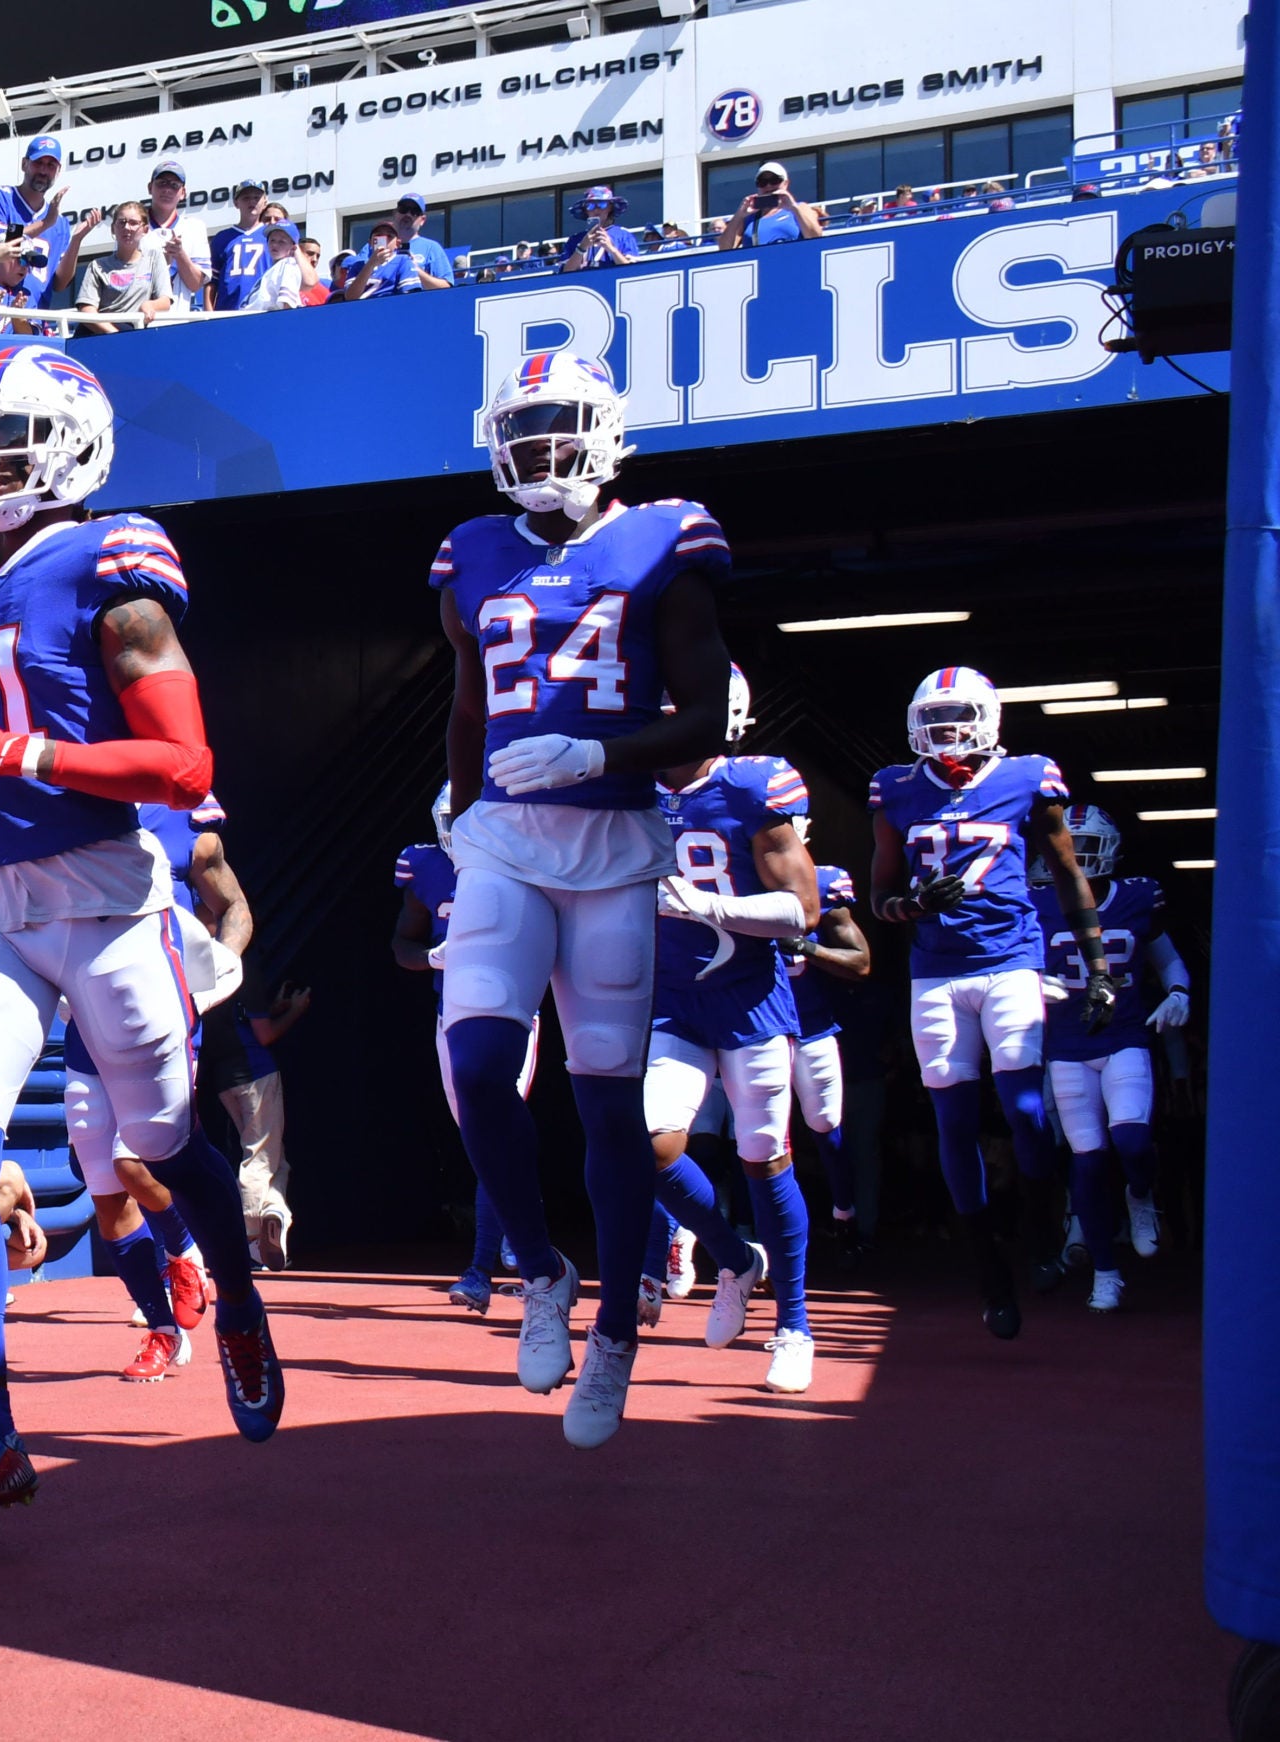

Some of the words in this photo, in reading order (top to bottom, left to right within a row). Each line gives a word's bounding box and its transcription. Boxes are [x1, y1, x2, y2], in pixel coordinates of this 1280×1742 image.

[310, 102, 349, 130] 34
[358, 82, 482, 118] COOKIE
[500, 48, 685, 93] GILCHRIST
[713, 95, 758, 131] 78
[782, 78, 904, 115] BRUCE
[922, 55, 1043, 92] SMITH
[68, 142, 126, 166] LOU
[140, 121, 253, 154] SABAN
[383, 153, 417, 181] 90
[435, 144, 506, 169] PHIL
[520, 118, 664, 156] HANSEN
[229, 243, 264, 277] 17
[1143, 239, 1236, 260] PRODIGY+
[473, 210, 1128, 449] BILLS
[530, 575, 572, 587] BILLS
[477, 590, 630, 720] 24
[673, 828, 738, 898] 8
[906, 820, 1011, 896] 37
